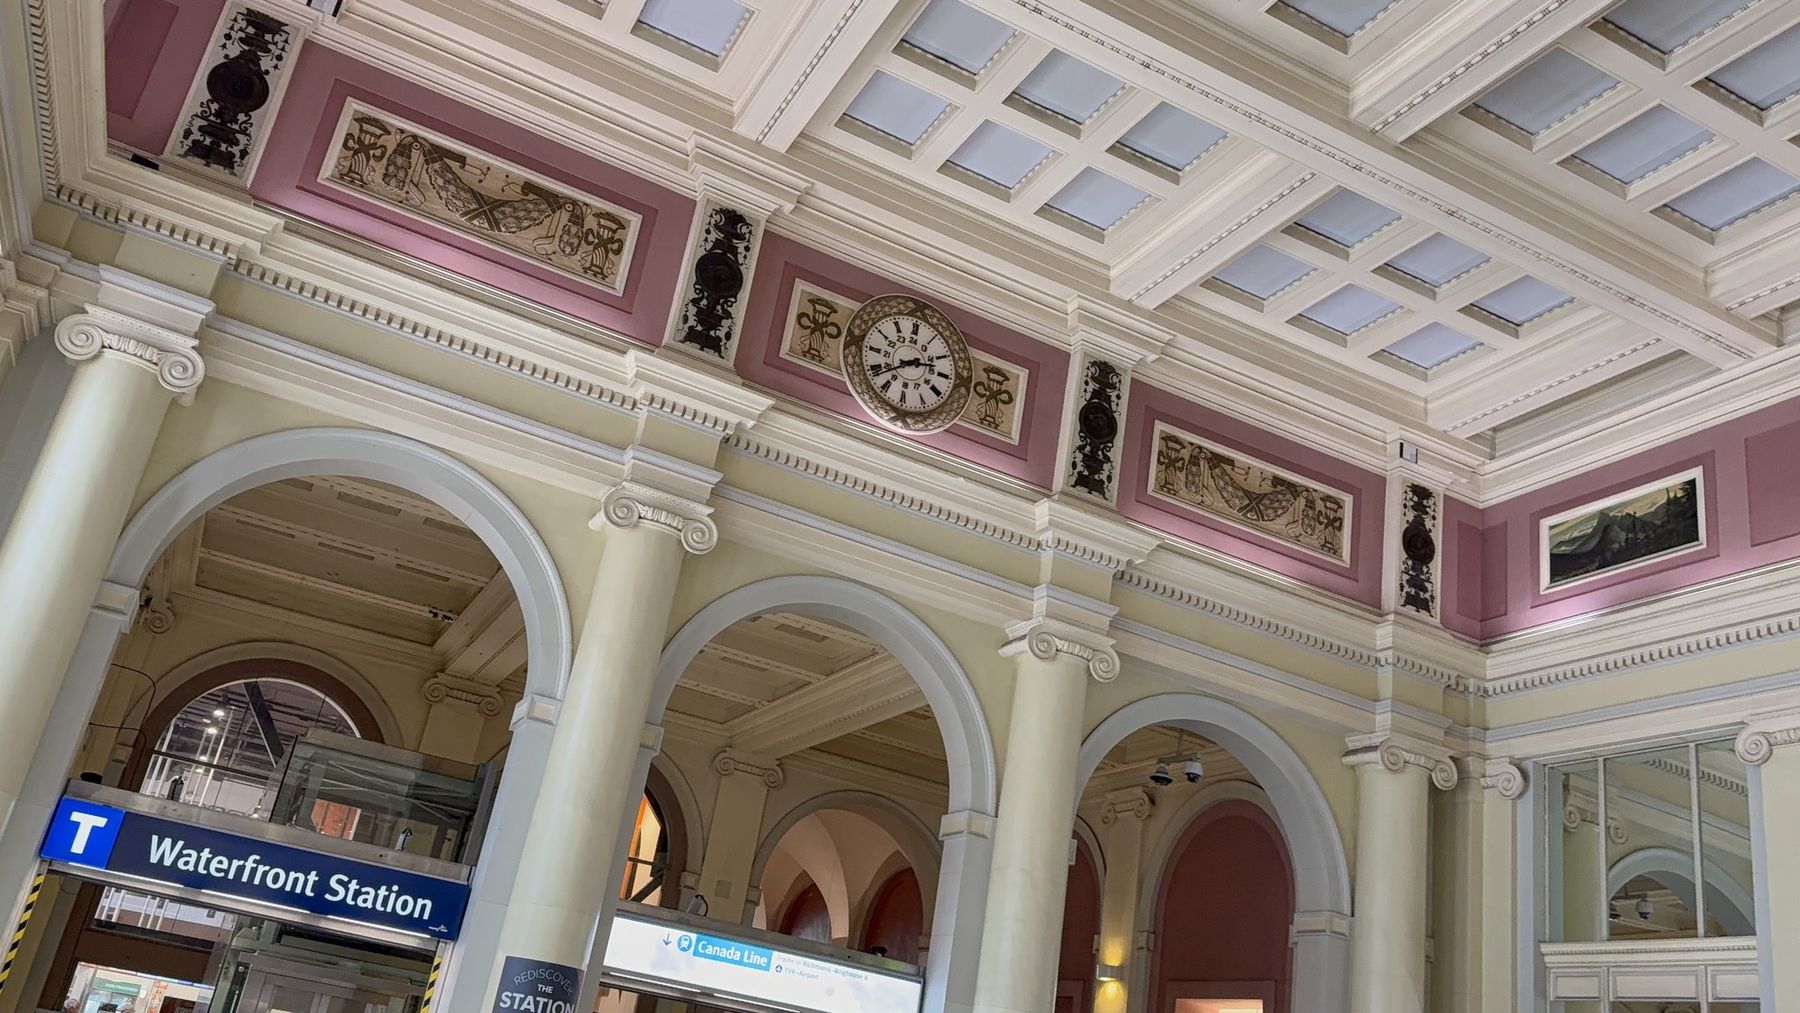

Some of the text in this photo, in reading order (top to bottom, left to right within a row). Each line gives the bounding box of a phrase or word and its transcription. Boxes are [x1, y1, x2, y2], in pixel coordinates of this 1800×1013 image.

[896, 335, 906, 344] 23
[909, 337, 918, 345] 24
[887, 340, 897, 349] 22
[921, 344, 928, 352] 13
[883, 351, 890, 359] 21
[928, 367, 935, 375] 15
[902, 381, 909, 389] 18
[923, 378, 931, 386] 16
[69, 811, 108, 855] T
[149, 834, 433, 921] Waterfront Station
[698, 940, 768, 967] Canada Line
[513, 968, 574, 996] REDISCOVER
[537, 984, 554, 994] THE
[500, 991, 575, 1013] STATION
